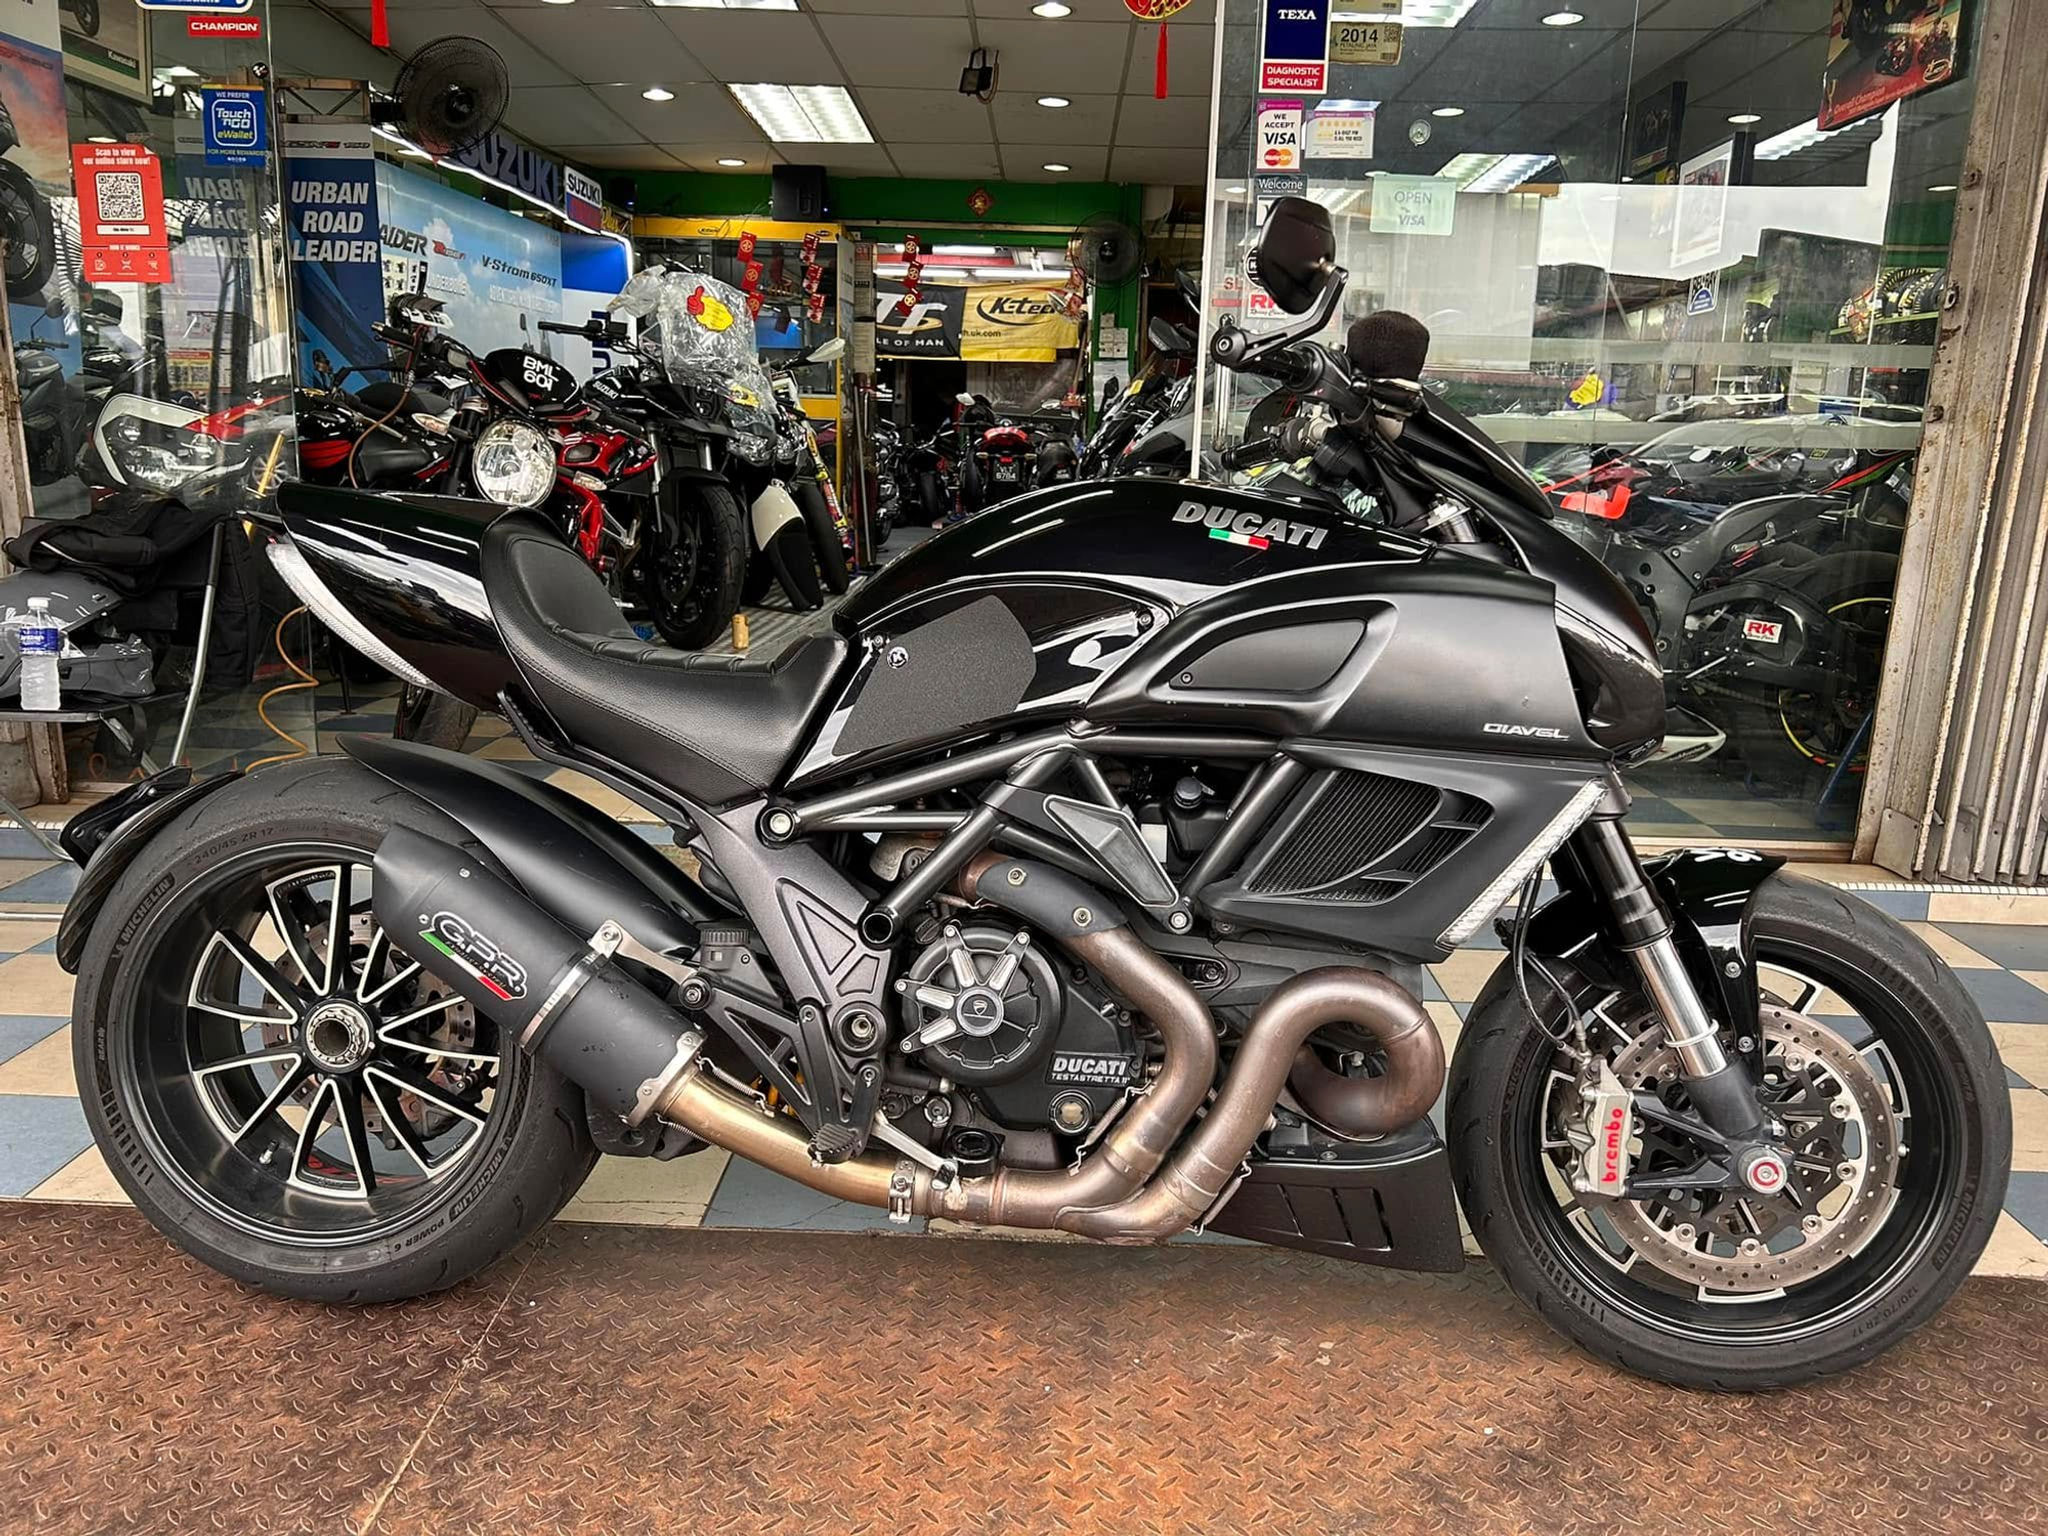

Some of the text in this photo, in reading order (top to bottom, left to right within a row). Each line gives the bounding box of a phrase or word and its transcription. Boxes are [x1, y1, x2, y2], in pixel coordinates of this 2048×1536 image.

[1277, 9, 1317, 20] TEXA
[191, 21, 258, 32] CHAMPION
[1340, 28, 1378, 43] 2014
[1267, 66, 1320, 75] DIAGNOSTIC
[1267, 77, 1318, 87] SPECIALIST
[216, 107, 251, 119] Touch
[1264, 121, 1295, 129] ACCEPT
[217, 130, 253, 139] eWallet
[1264, 132, 1296, 145] VISA
[457, 131, 562, 205] SUZUKI
[567, 172, 602, 204] SUZUKI
[1258, 178, 1303, 190] Welcome
[291, 181, 369, 205] URBAN
[1394, 190, 1432, 204] OPEN
[303, 210, 363, 233] ROAD
[1398, 214, 1425, 226] VISA
[292, 240, 378, 264] LEADER
[531, 271, 558, 288] 650XT
[915, 339, 944, 347] MAN
[523, 356, 559, 382] BML
[593, 380, 619, 400] SUZUKI
[1172, 500, 1329, 550] DUCATI
[1747, 621, 1777, 636] RK
[1483, 722, 1569, 740] DIAVEL
[121, 873, 174, 943] MICHELIN
[1053, 1057, 1127, 1076] DUCATI
[1051, 1073, 1120, 1084] TESTASTRETTA
[1602, 1108, 1624, 1183] brembo
[453, 1152, 503, 1216] MICHELIN
[405, 1218, 445, 1247] POWER
